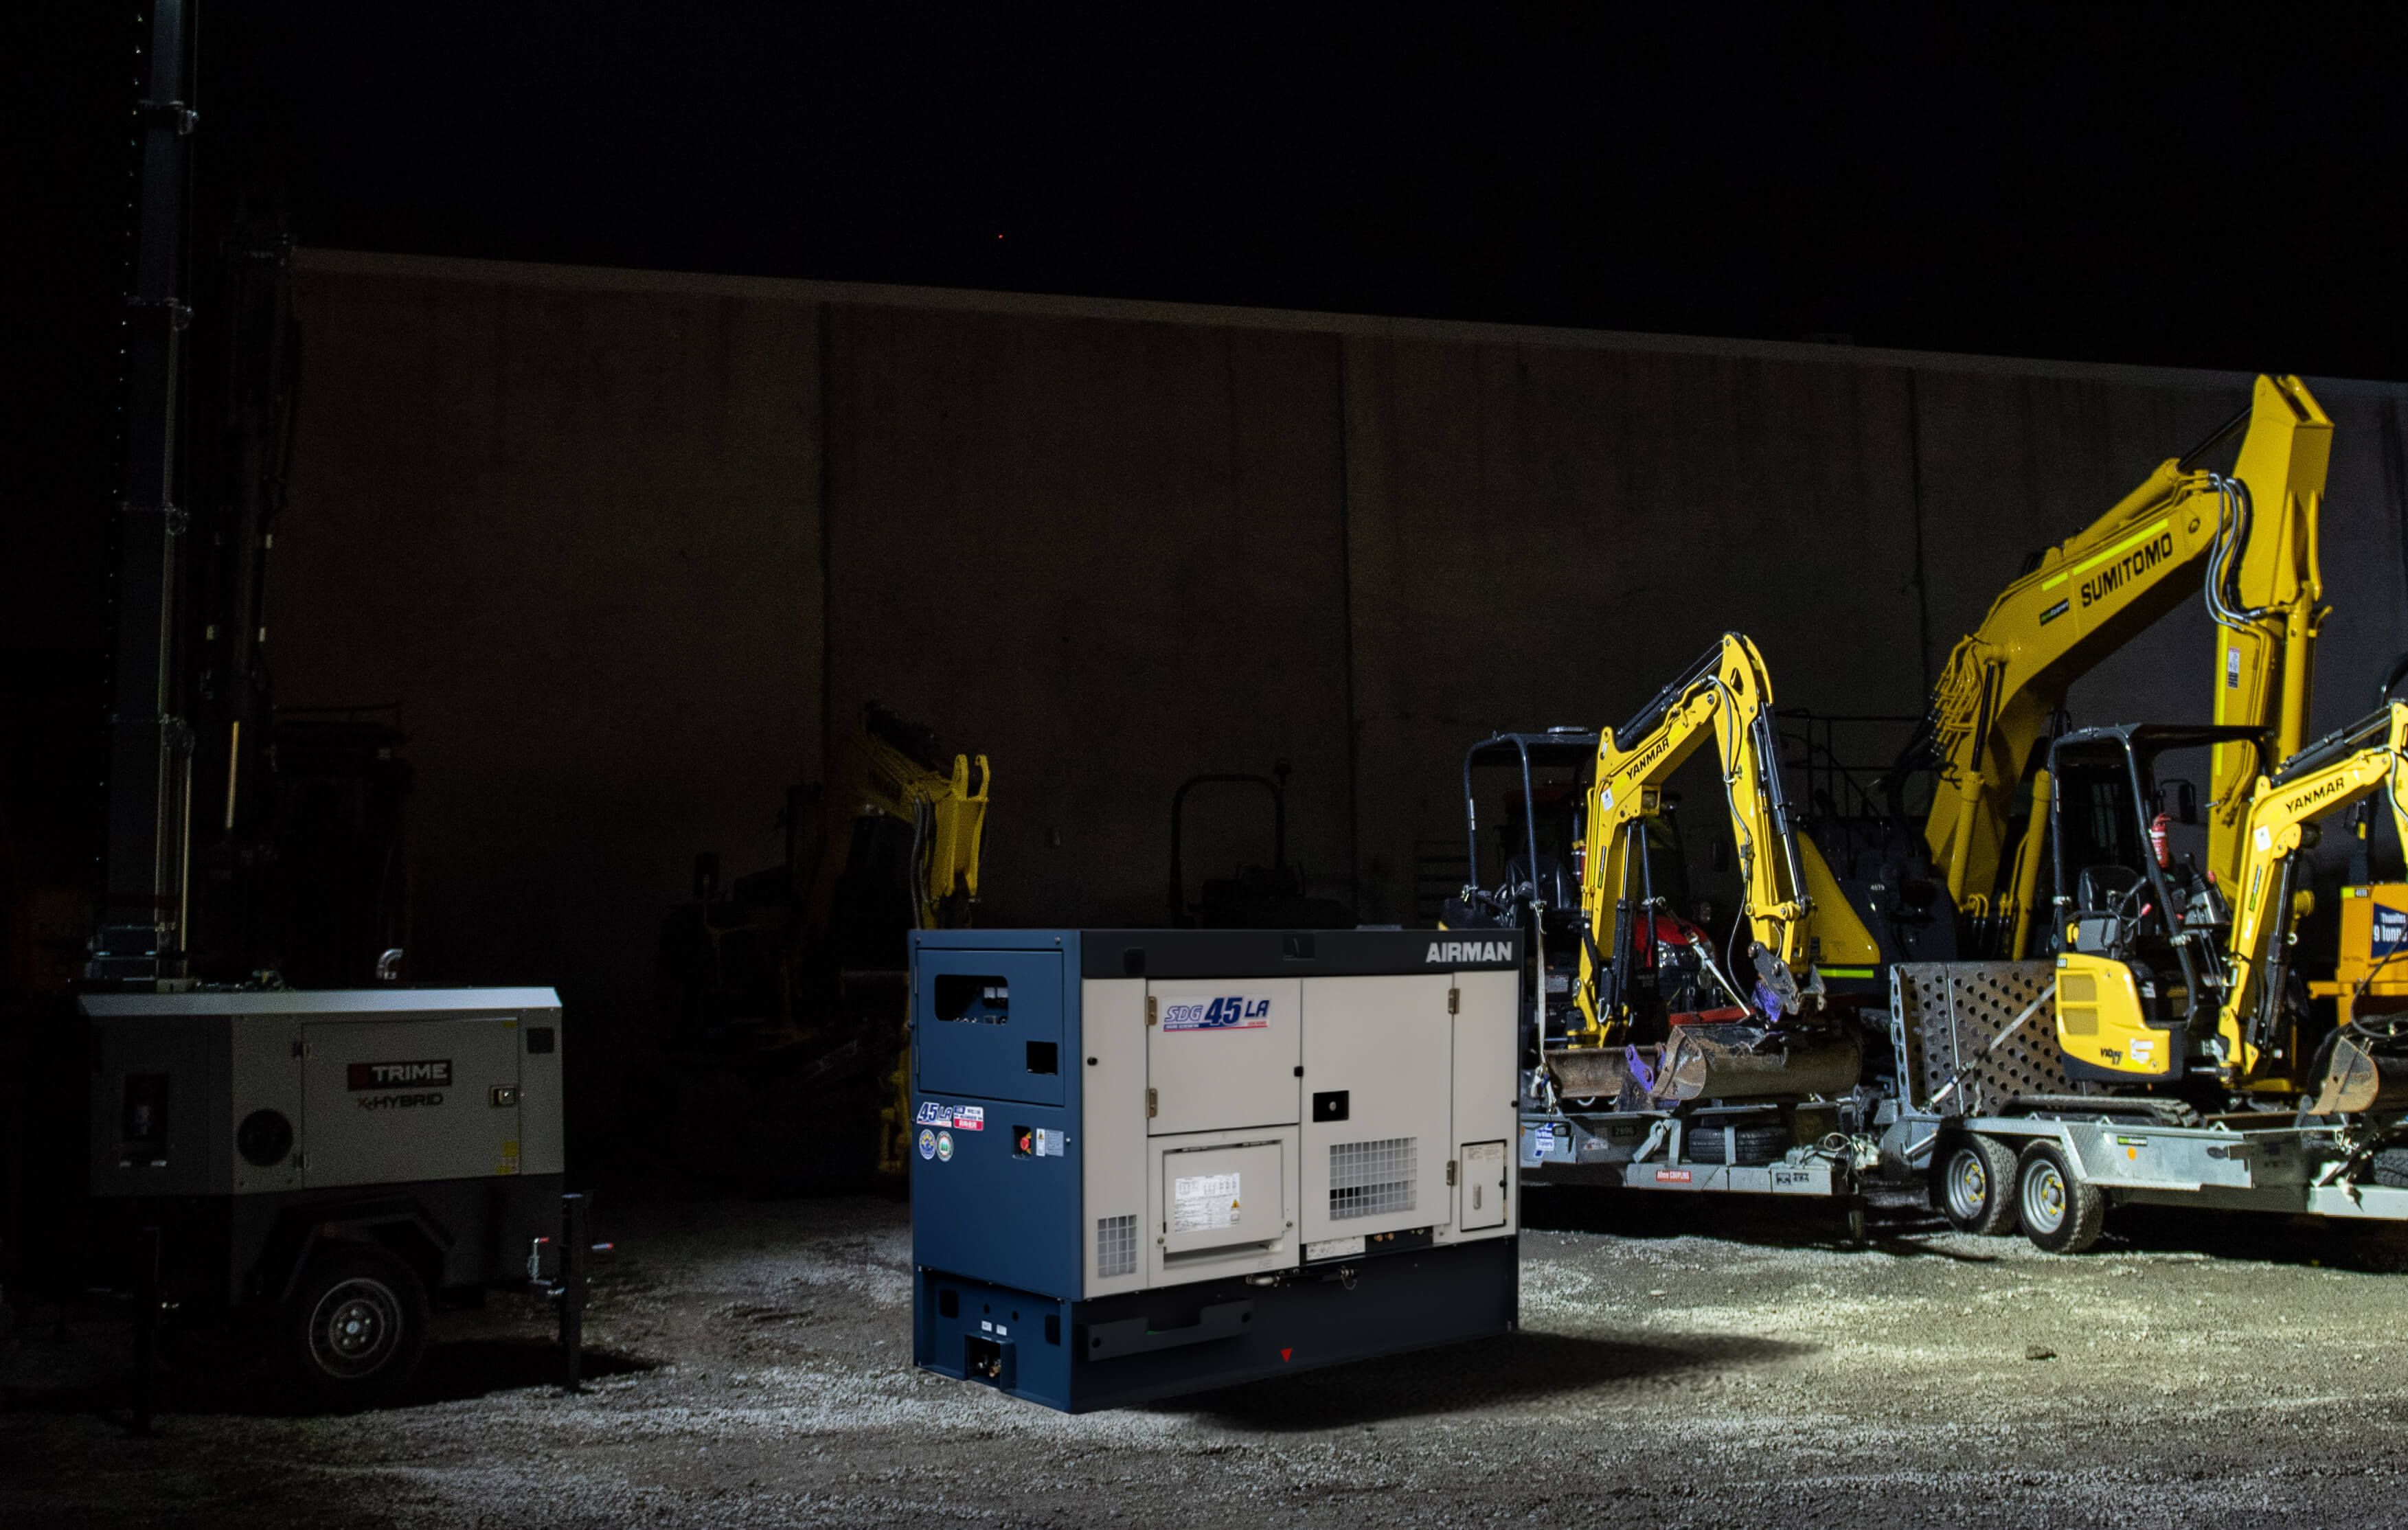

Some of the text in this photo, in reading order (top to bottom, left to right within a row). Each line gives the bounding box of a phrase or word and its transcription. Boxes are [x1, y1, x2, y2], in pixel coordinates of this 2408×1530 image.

[2081, 533, 2172, 608] SUMITOMO
[1626, 738, 1669, 780] YANMAR
[2286, 777, 2344, 814] YANMAR
[2374, 924, 2380, 942] 9
[1425, 941, 1512, 963] AIRMAN
[1164, 997, 1270, 1025] SDG 45 LA
[371, 1064, 447, 1082] TRIME
[920, 1103, 939, 1121] 45
[939, 1106, 952, 1119] LA
